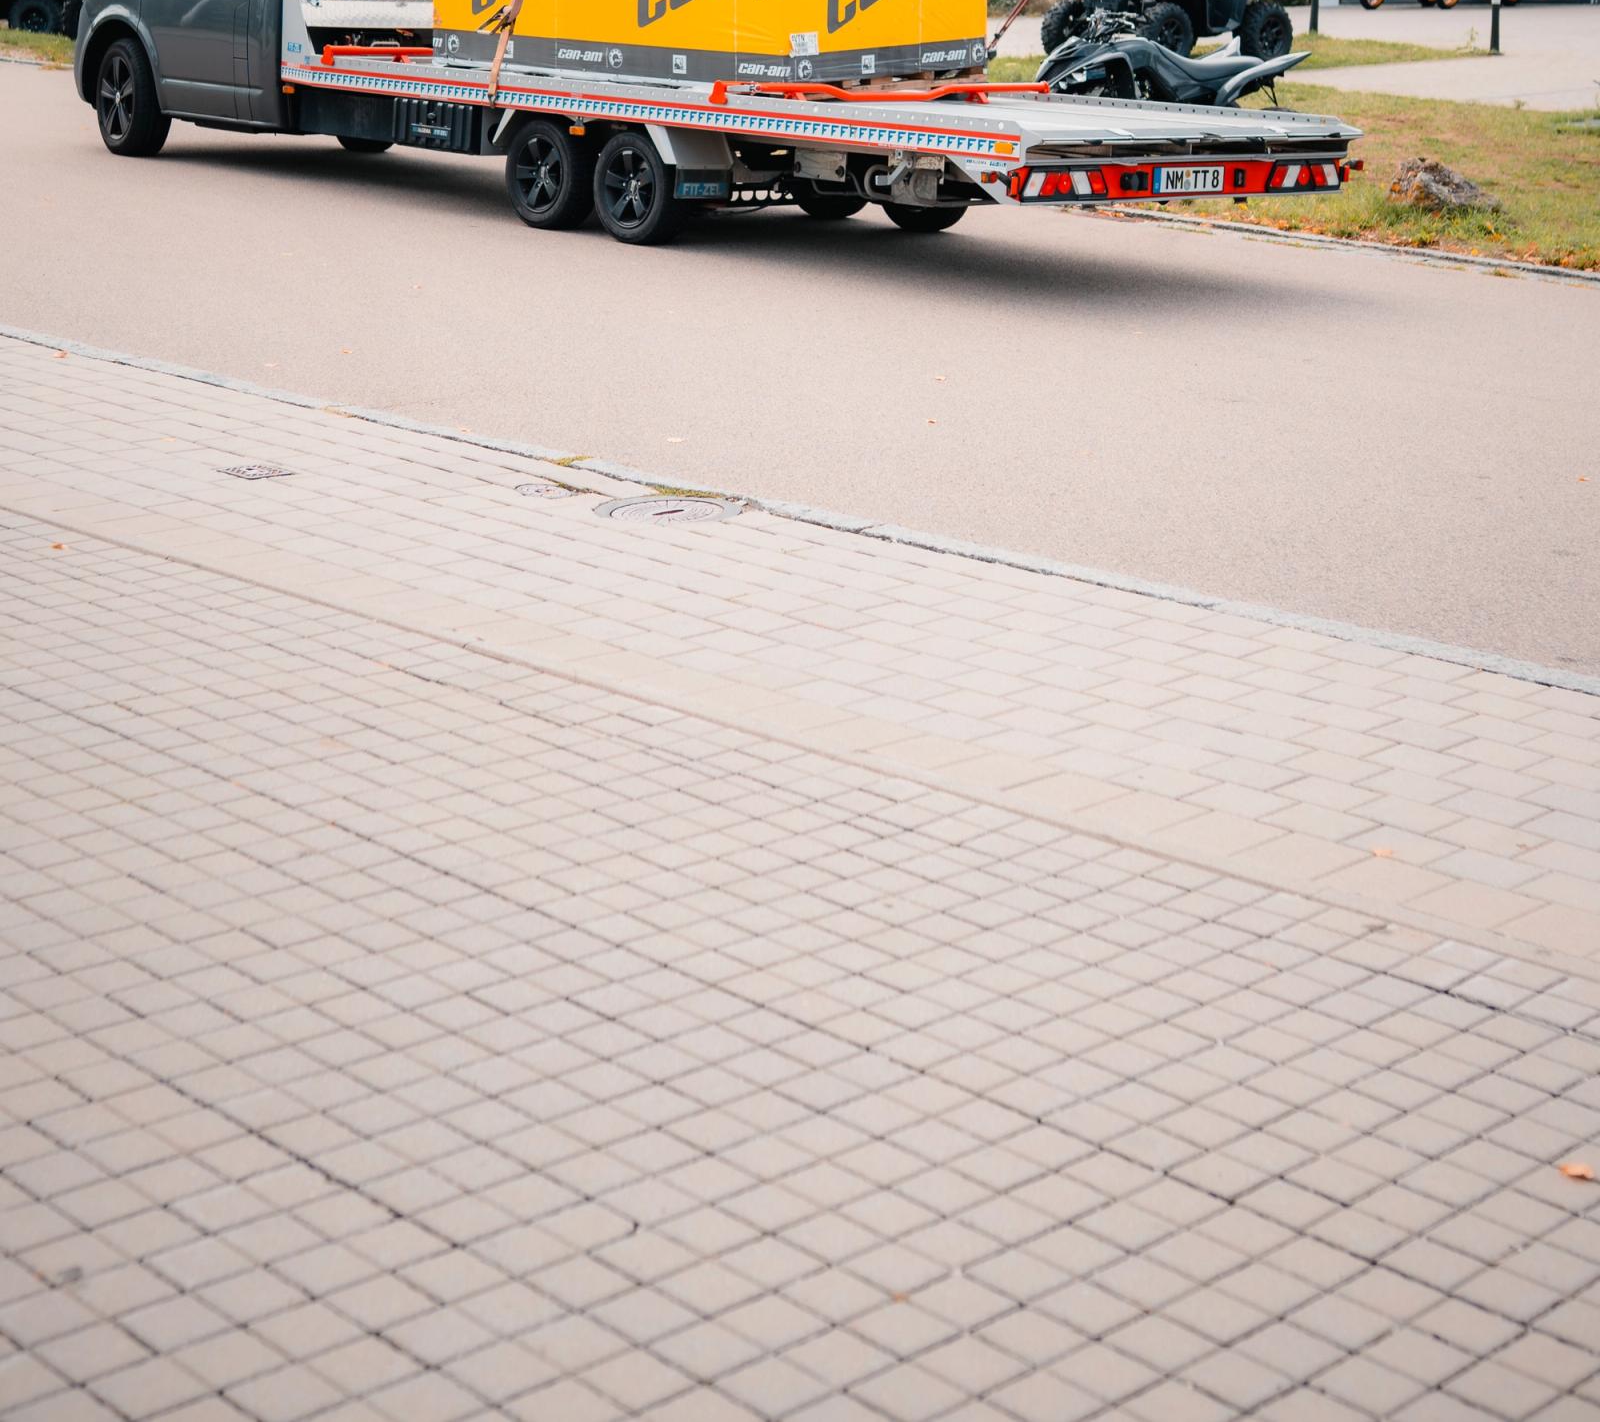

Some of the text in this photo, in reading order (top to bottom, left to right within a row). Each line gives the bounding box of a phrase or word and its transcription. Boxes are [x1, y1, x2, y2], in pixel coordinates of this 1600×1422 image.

[558, 48, 603, 63] can-am
[922, 49, 967, 64] can-am
[738, 62, 792, 78] can-am
[1166, 169, 1220, 190] NM TT 8
